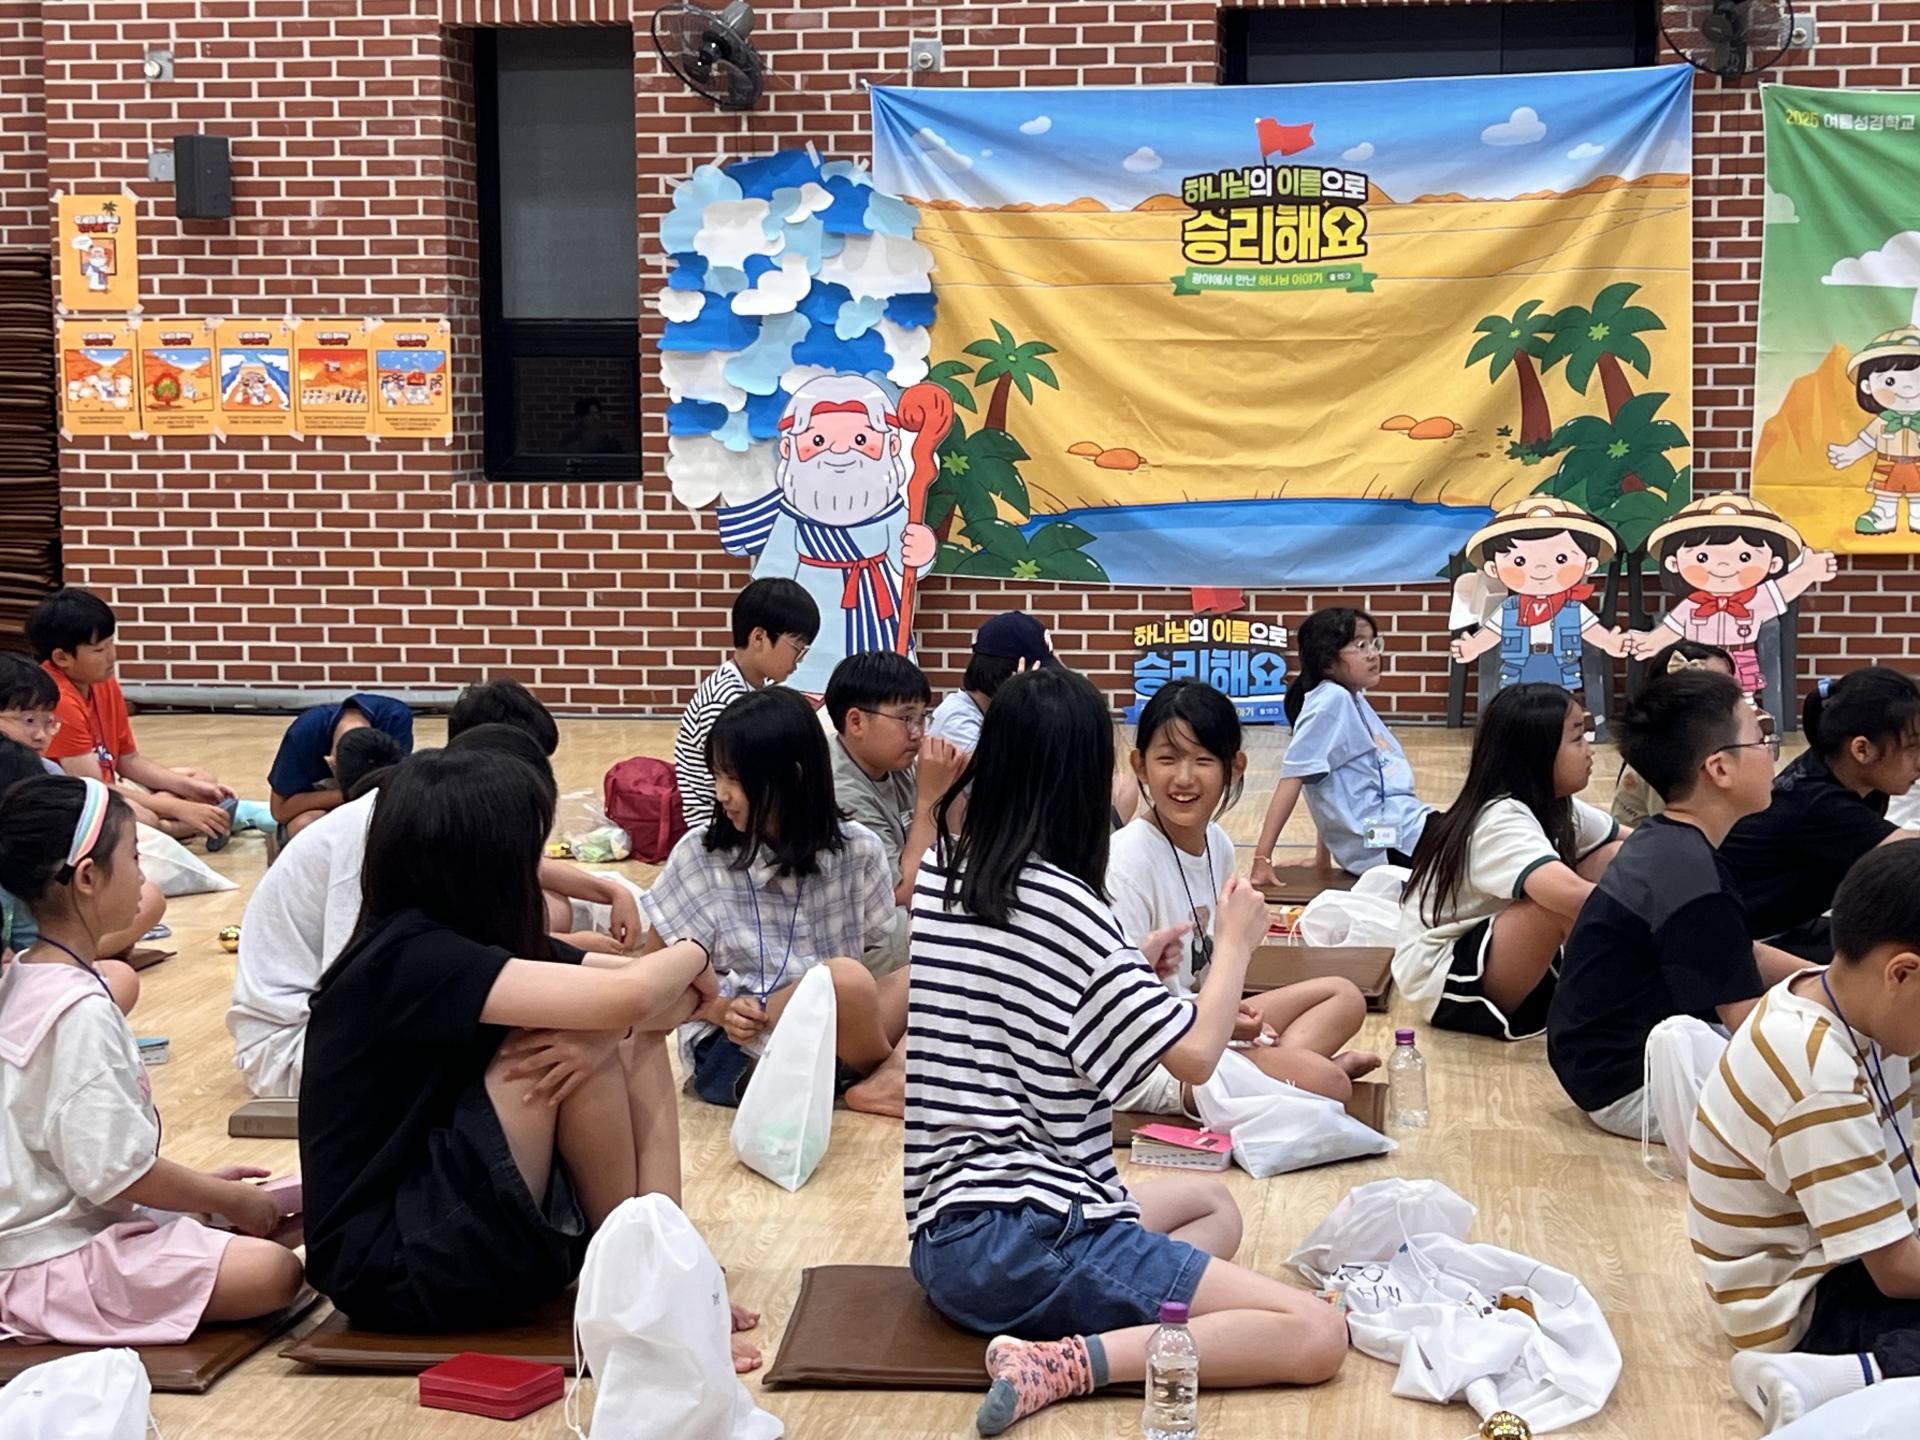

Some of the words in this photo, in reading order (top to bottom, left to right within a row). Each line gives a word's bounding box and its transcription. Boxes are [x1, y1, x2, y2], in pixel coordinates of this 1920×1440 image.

[1786, 109, 1819, 128] 2025
[1823, 112, 1916, 132] 여름성경학교
[1183, 167, 1273, 204] 하나님의
[1276, 166, 1367, 200] 이름으로
[1183, 204, 1367, 263] 승리해요
[1191, 271, 1233, 286] 광야에서
[1234, 273, 1257, 287] 만난
[1258, 272, 1290, 286] 하나님
[1291, 271, 1323, 285] 이야기
[1133, 618, 1209, 647] 하나님의
[1211, 618, 1289, 648] 이름으로
[1133, 649, 1288, 697] 승리해요
